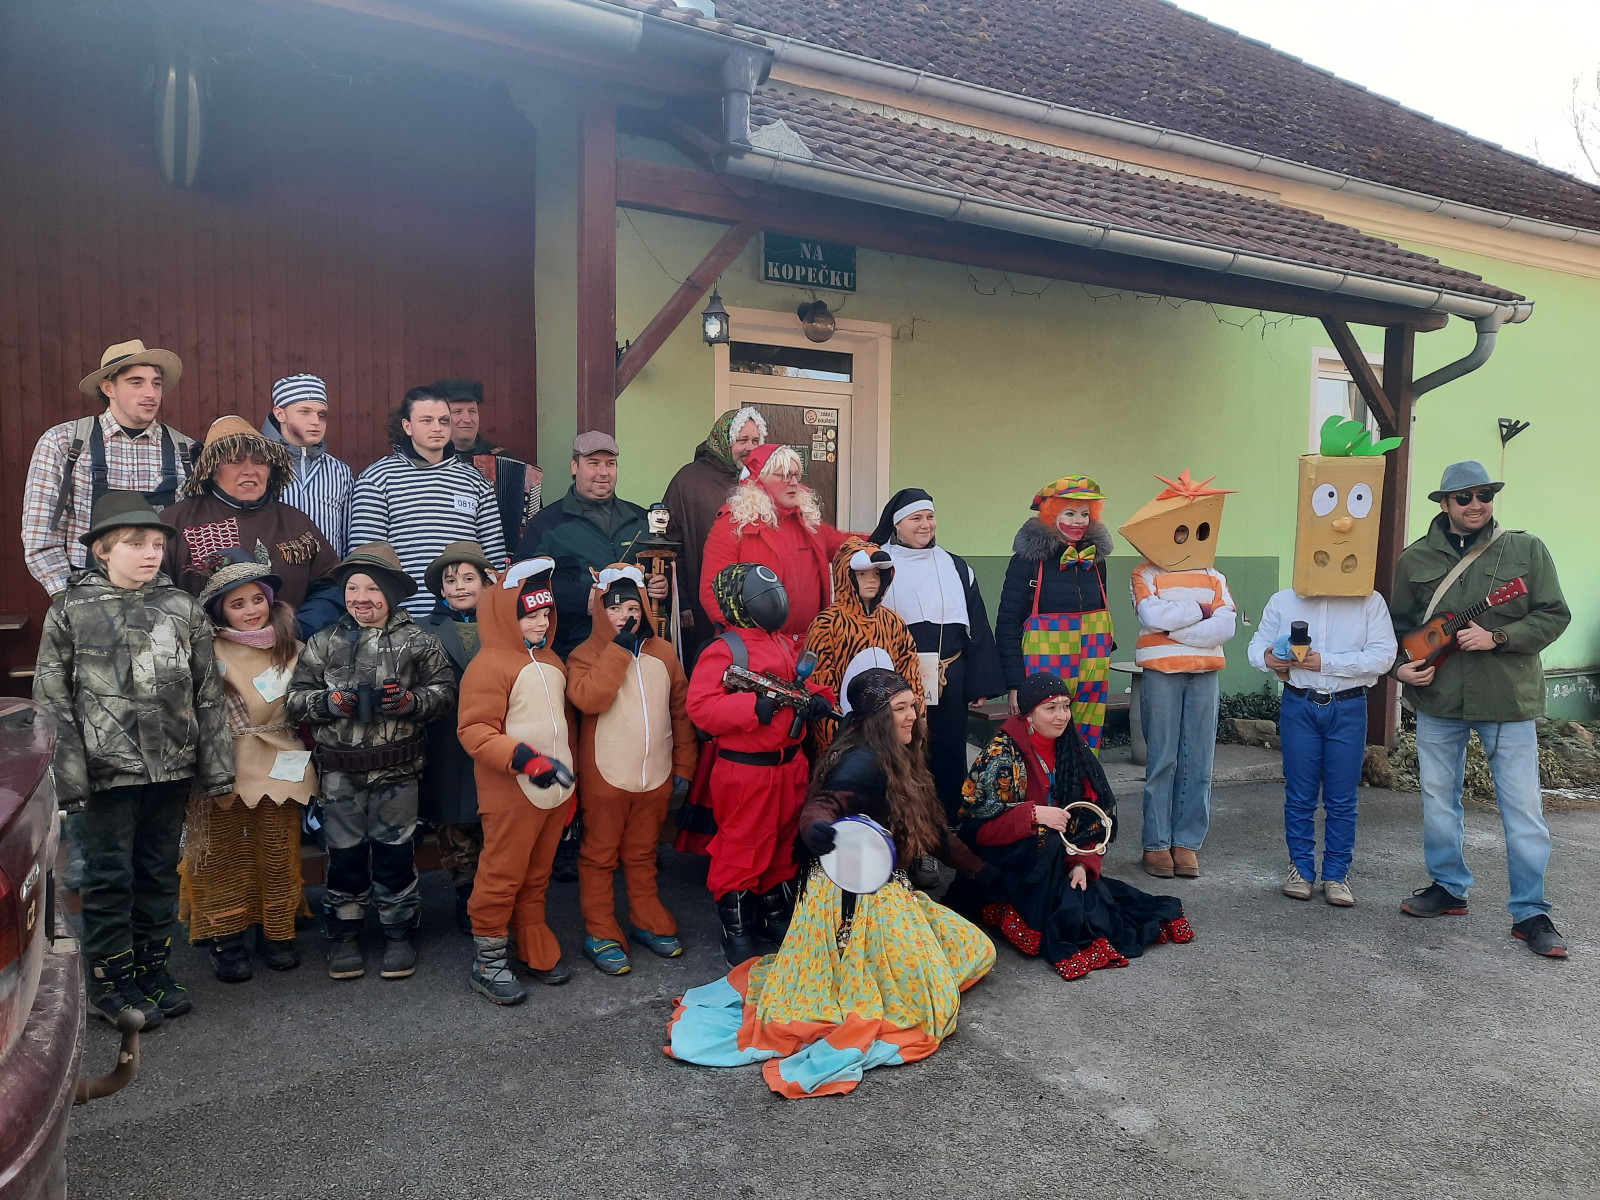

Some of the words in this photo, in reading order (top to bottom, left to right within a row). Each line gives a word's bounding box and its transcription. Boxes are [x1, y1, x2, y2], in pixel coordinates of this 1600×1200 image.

[800, 242, 824, 261] NA
[767, 261, 855, 288] KOPEČKU
[458, 500, 475, 510] 0815
